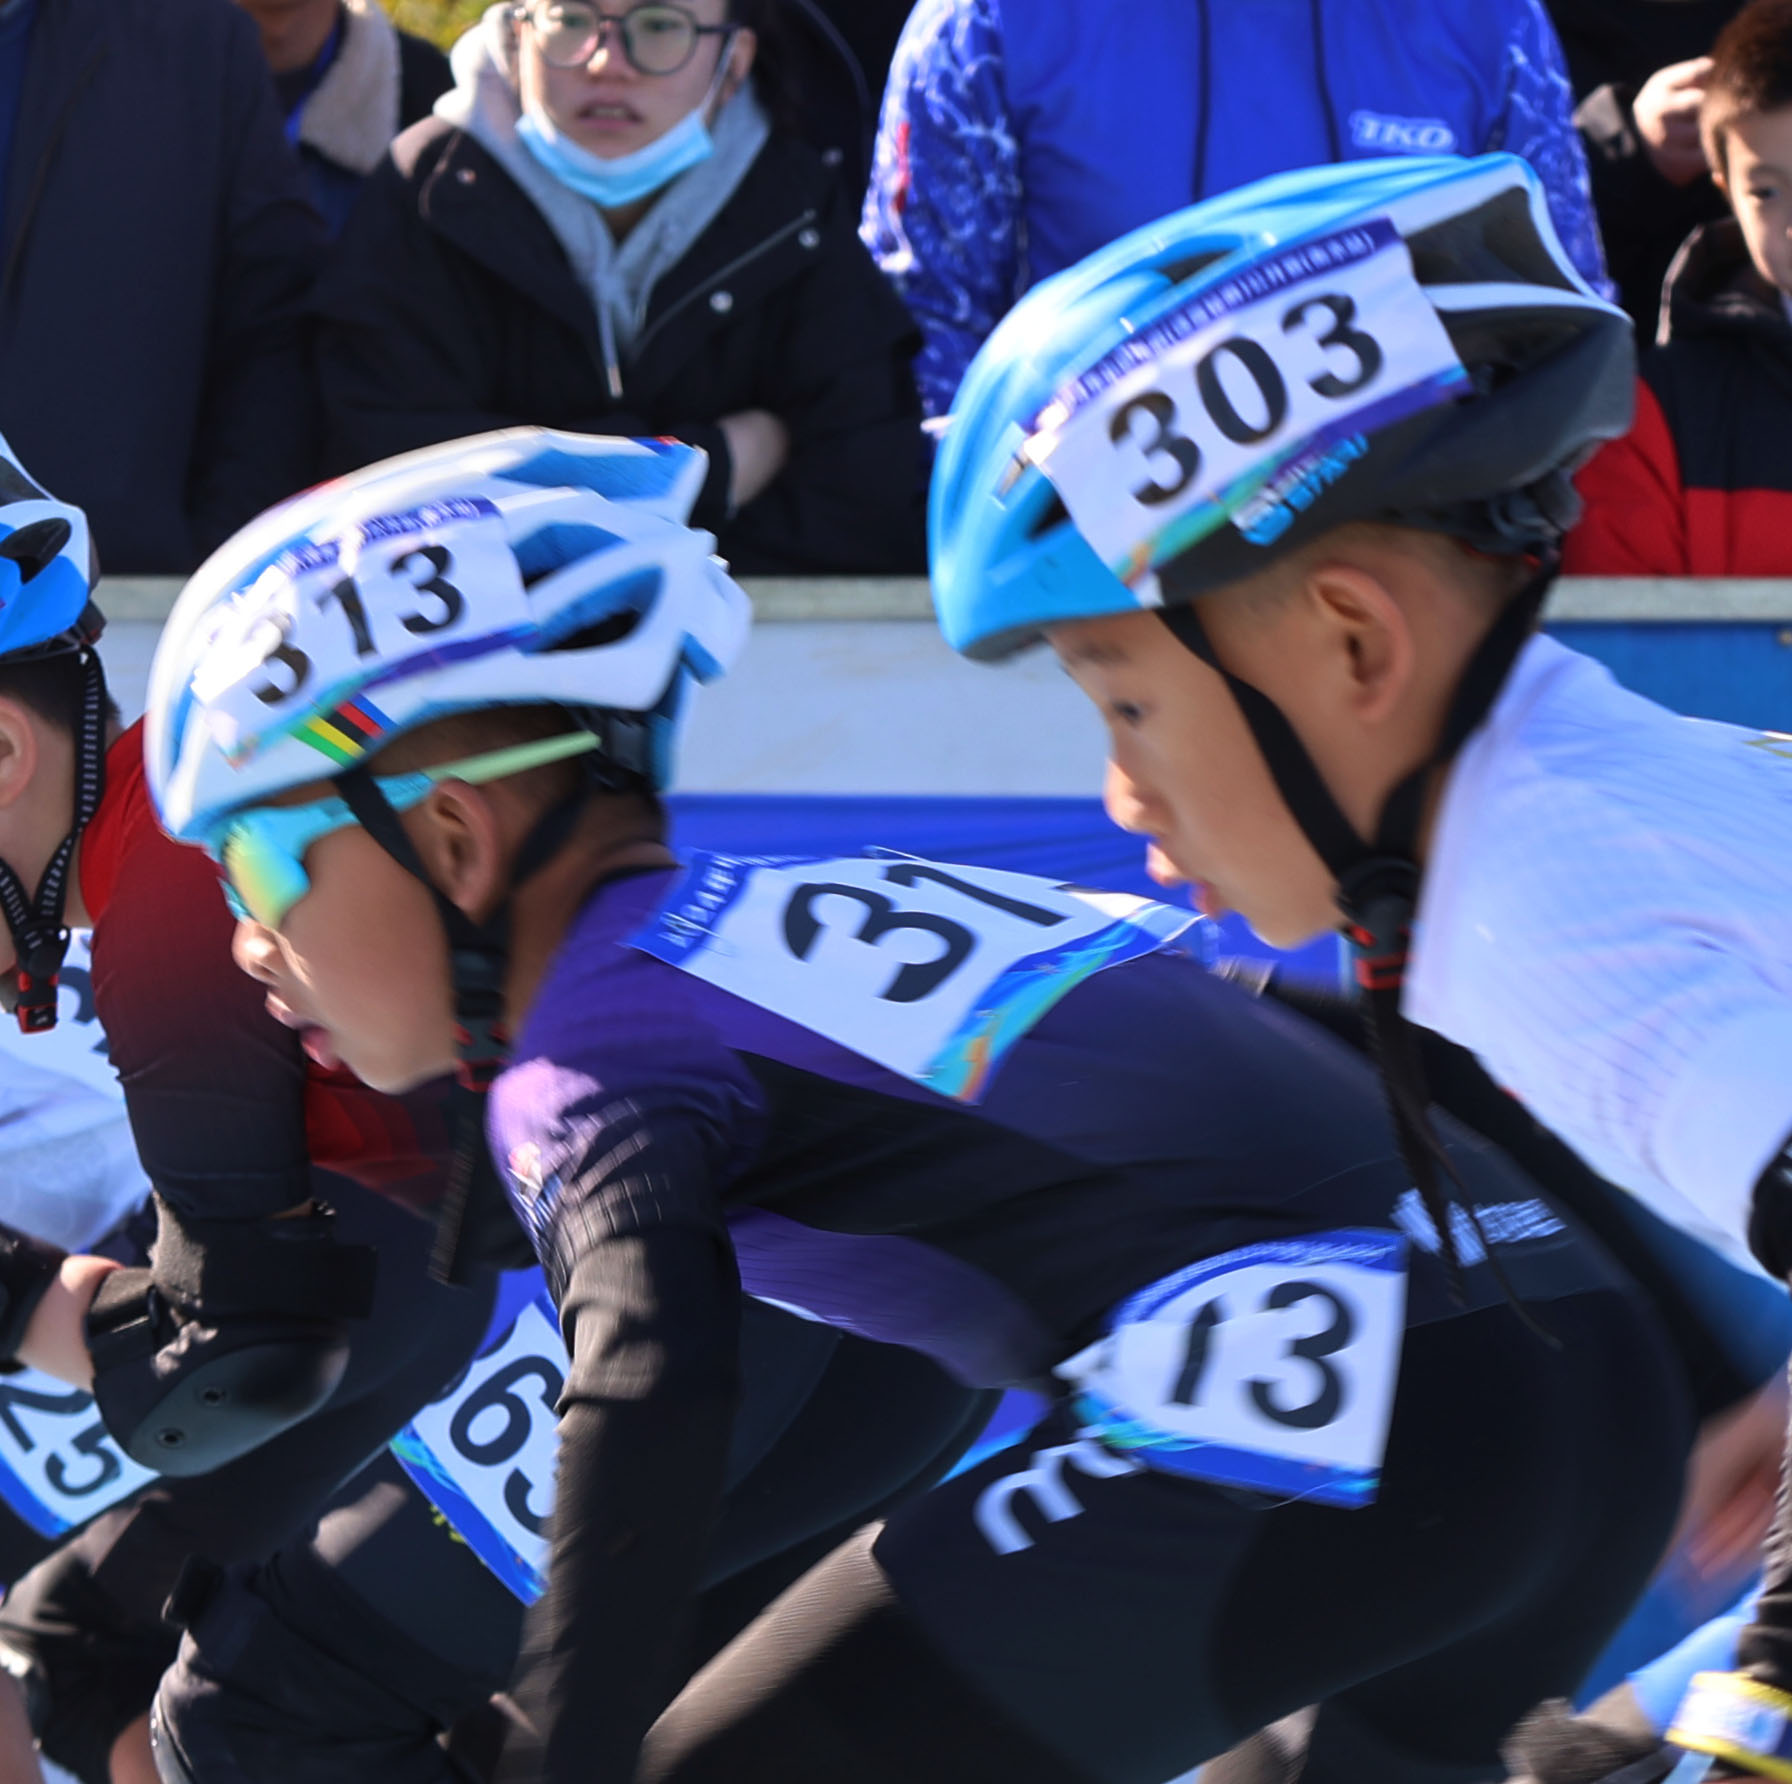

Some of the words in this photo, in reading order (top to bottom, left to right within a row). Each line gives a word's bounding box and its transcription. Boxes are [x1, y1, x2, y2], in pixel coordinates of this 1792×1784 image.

[1108, 293, 1384, 506] 303
[250, 544, 466, 705] 313
[781, 861, 1098, 1004] 31
